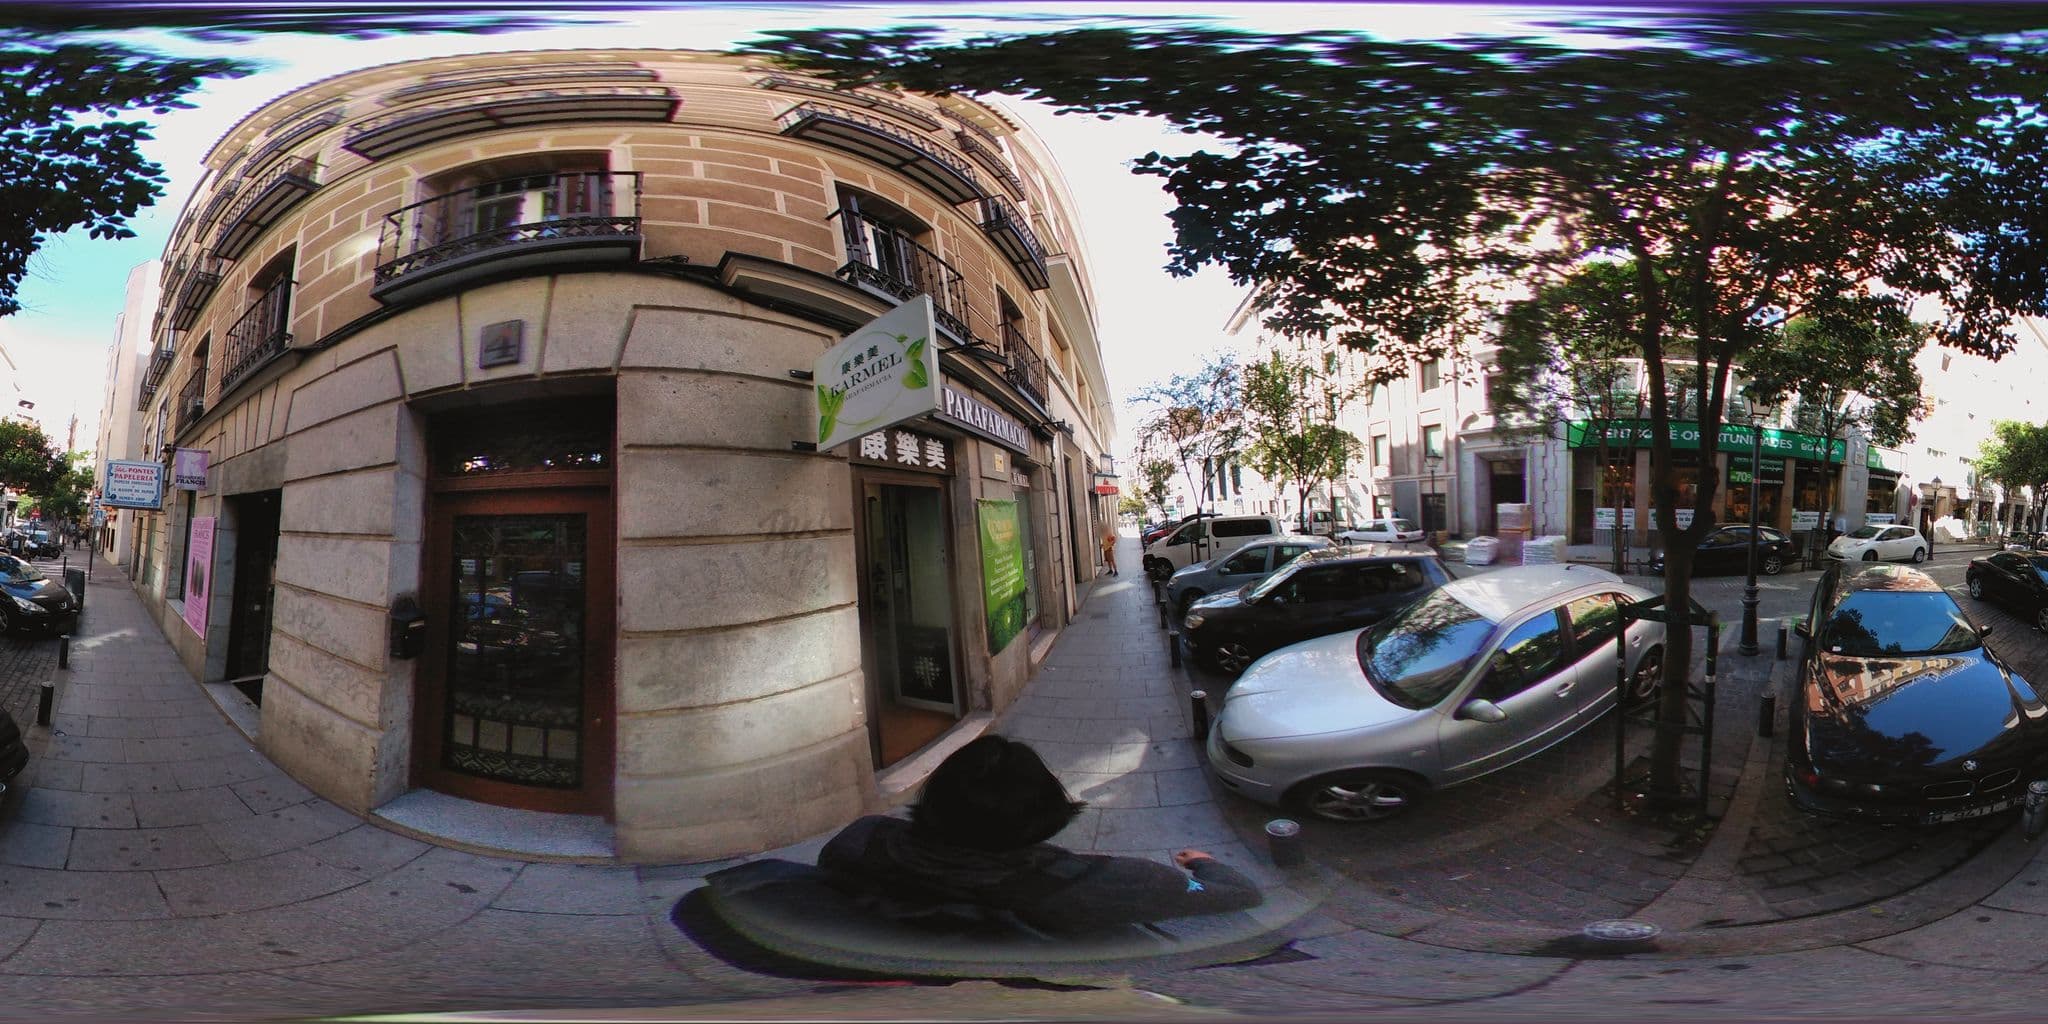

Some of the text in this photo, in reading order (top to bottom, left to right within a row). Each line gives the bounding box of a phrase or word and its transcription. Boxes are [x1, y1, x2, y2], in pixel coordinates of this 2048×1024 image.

[830, 351, 903, 399] KARMEL
[845, 373, 892, 400] ARAFARMACIA
[944, 387, 1028, 450] PARAFARMACIA
[860, 429, 946, 470] 康樂美
